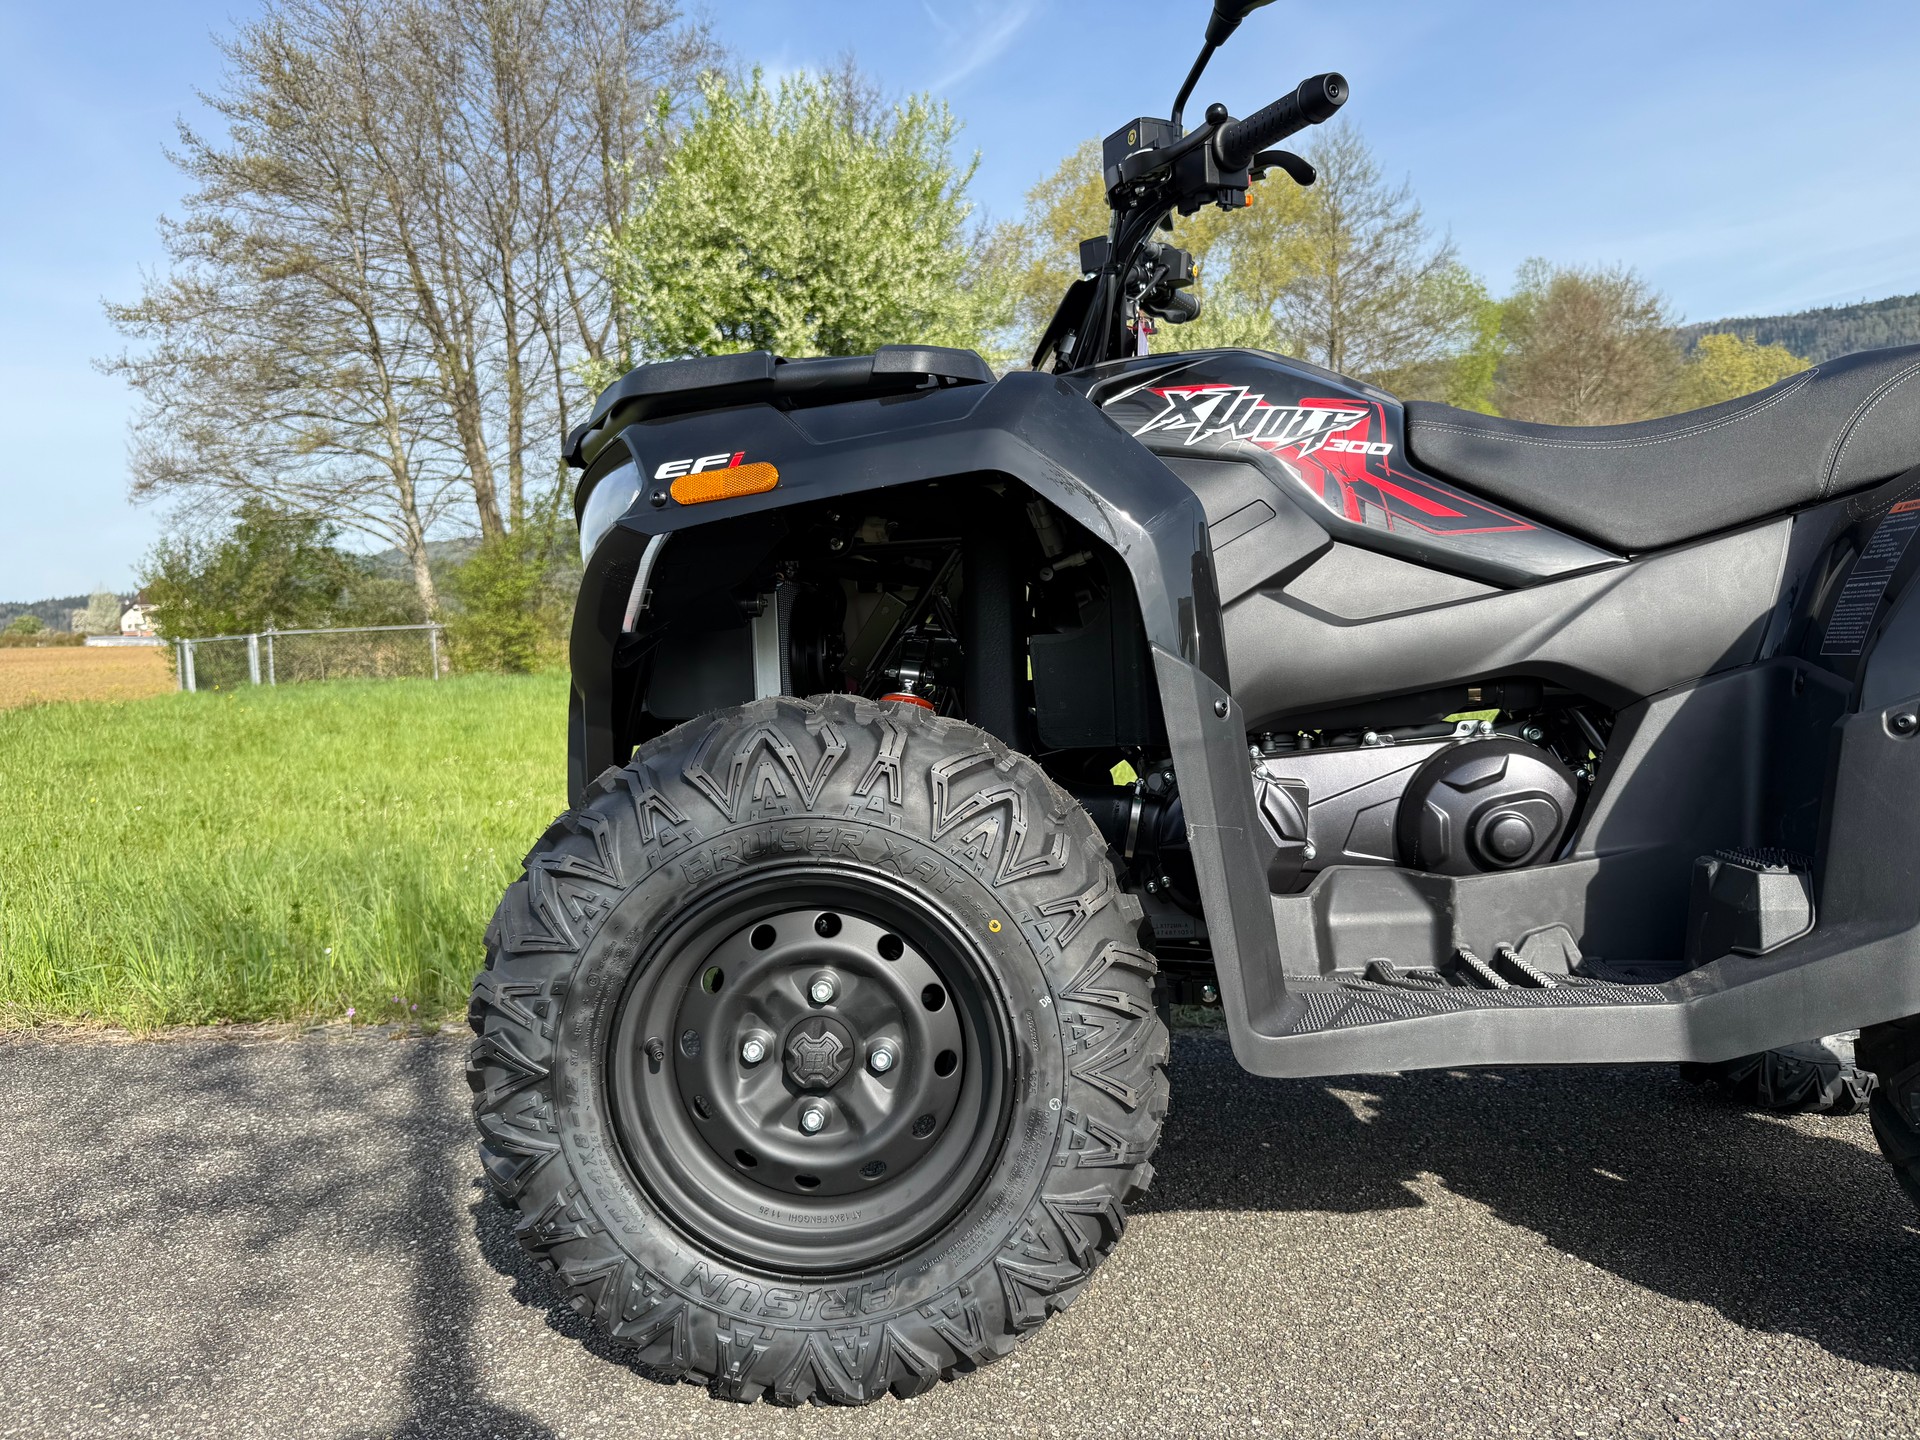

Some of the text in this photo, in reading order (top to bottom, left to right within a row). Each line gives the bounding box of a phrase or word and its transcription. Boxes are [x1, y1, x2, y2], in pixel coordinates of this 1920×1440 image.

[1323, 438, 1394, 456] 300
[680, 825, 865, 885] BRUISER
[951, 898, 973, 921] NYLON
[680, 1260, 898, 1321] ARISUN
